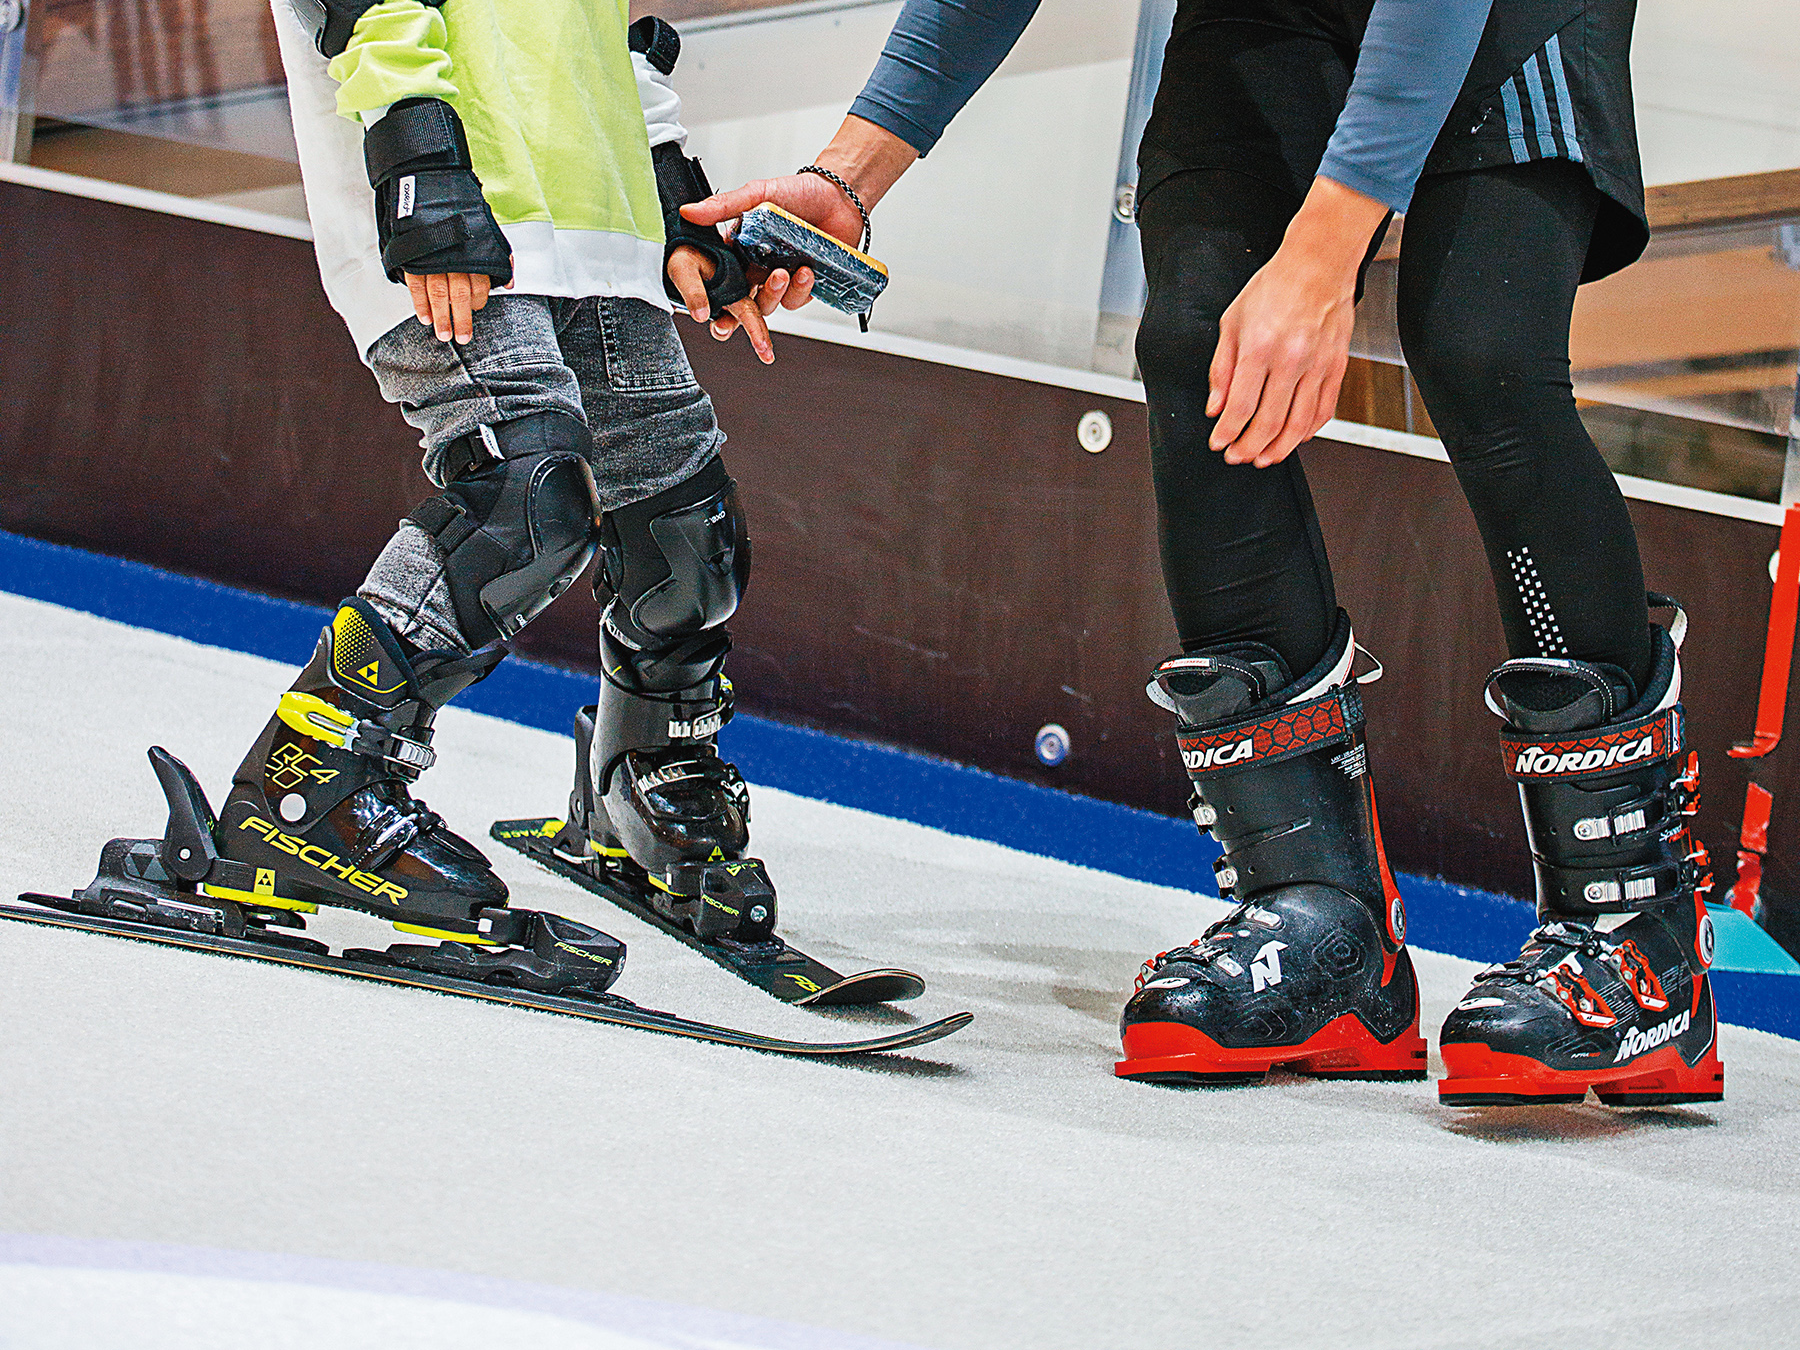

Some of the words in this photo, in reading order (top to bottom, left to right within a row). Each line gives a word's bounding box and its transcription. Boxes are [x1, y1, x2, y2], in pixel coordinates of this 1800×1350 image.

[272, 742, 341, 785] RC4
[1181, 738, 1253, 769] RDICA
[1515, 736, 1653, 774] NORDICA
[238, 816, 409, 906] FISCHER
[701, 893, 740, 917] FISCHER
[553, 941, 613, 967] FISCHER
[1612, 1009, 1690, 1063] NORDICA
